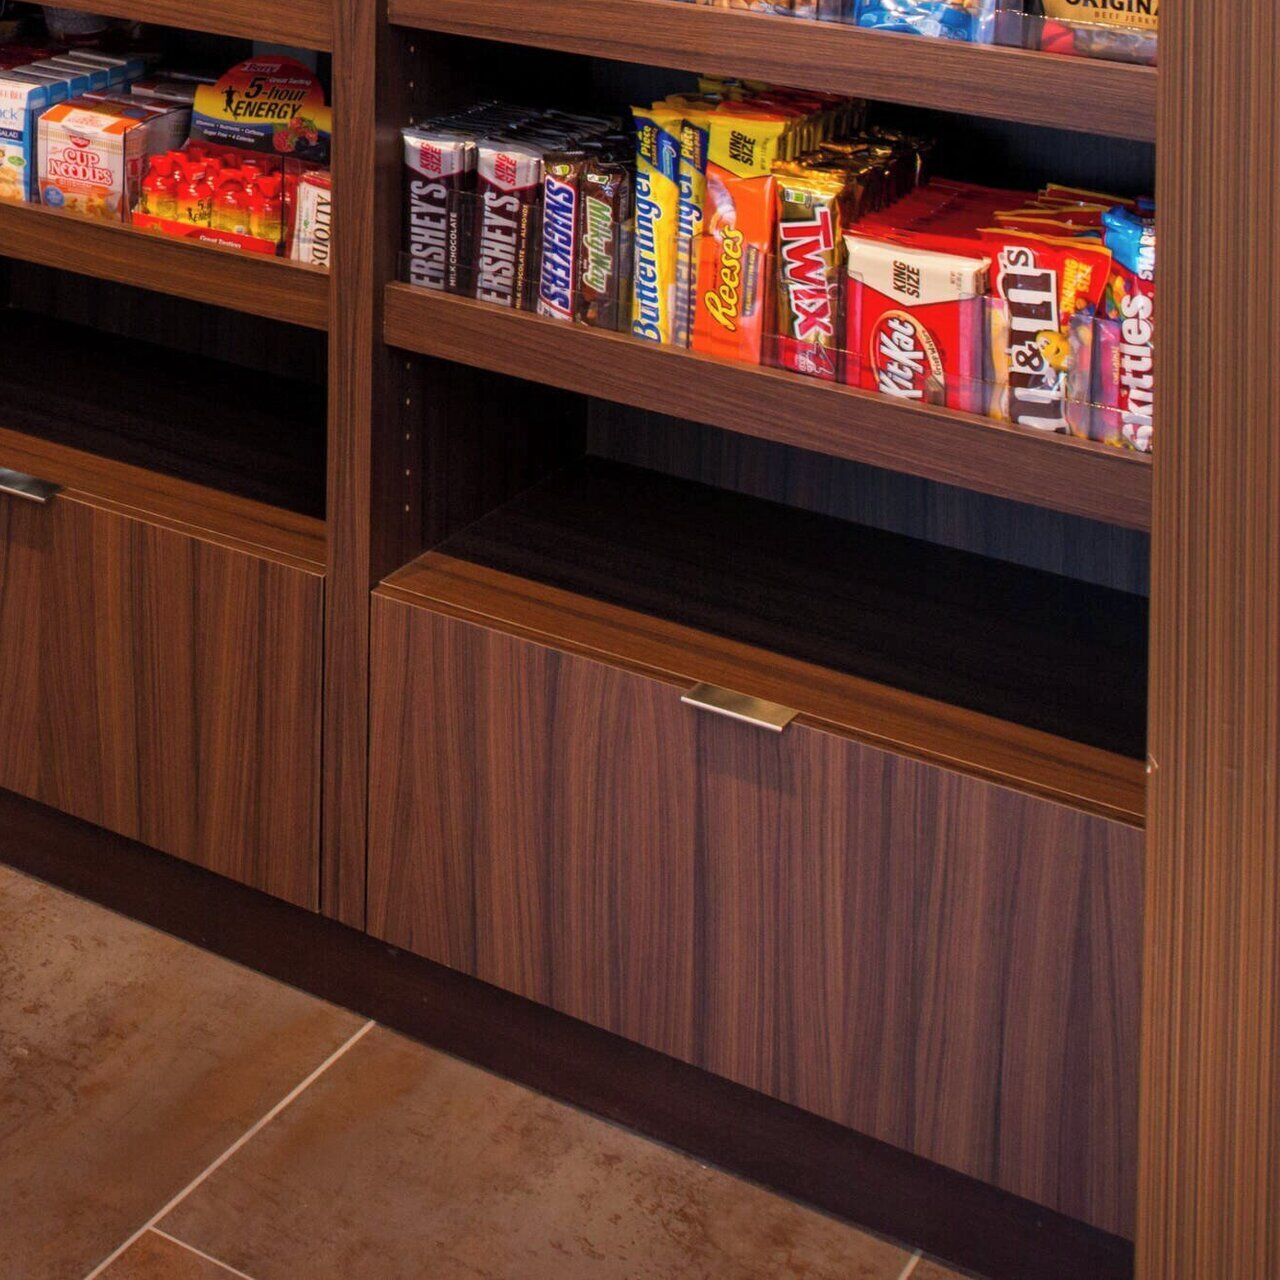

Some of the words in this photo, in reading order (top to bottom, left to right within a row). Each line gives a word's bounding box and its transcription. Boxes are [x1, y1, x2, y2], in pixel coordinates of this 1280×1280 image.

[245, 76, 307, 102] 5-hour
[233, 100, 302, 120] ENERGY
[63, 147, 100, 166] CUP
[419, 141, 432, 170] KING
[429, 146, 442, 175] SIZE
[728, 129, 745, 162] KING
[740, 135, 757, 167] SIZE
[49, 158, 113, 187] NOODLES
[494, 152, 507, 182] KING
[503, 158, 518, 187] SIZE
[410, 180, 448, 291] ERSHEY'S
[449, 211, 458, 267] CHOCOLATE
[583, 196, 613, 259] Milky
[477, 190, 521, 307] ERSHEY'S
[541, 178, 575, 311] SNICKERS
[633, 171, 662, 345] Butterfinger
[449, 267, 458, 287] MILK
[582, 254, 613, 294] Way
[705, 225, 744, 332] Reese's
[779, 207, 834, 340] TWIX
[893, 259, 907, 292] KING
[906, 266, 920, 297] SIZE
[1121, 294, 1154, 453] Skittles
